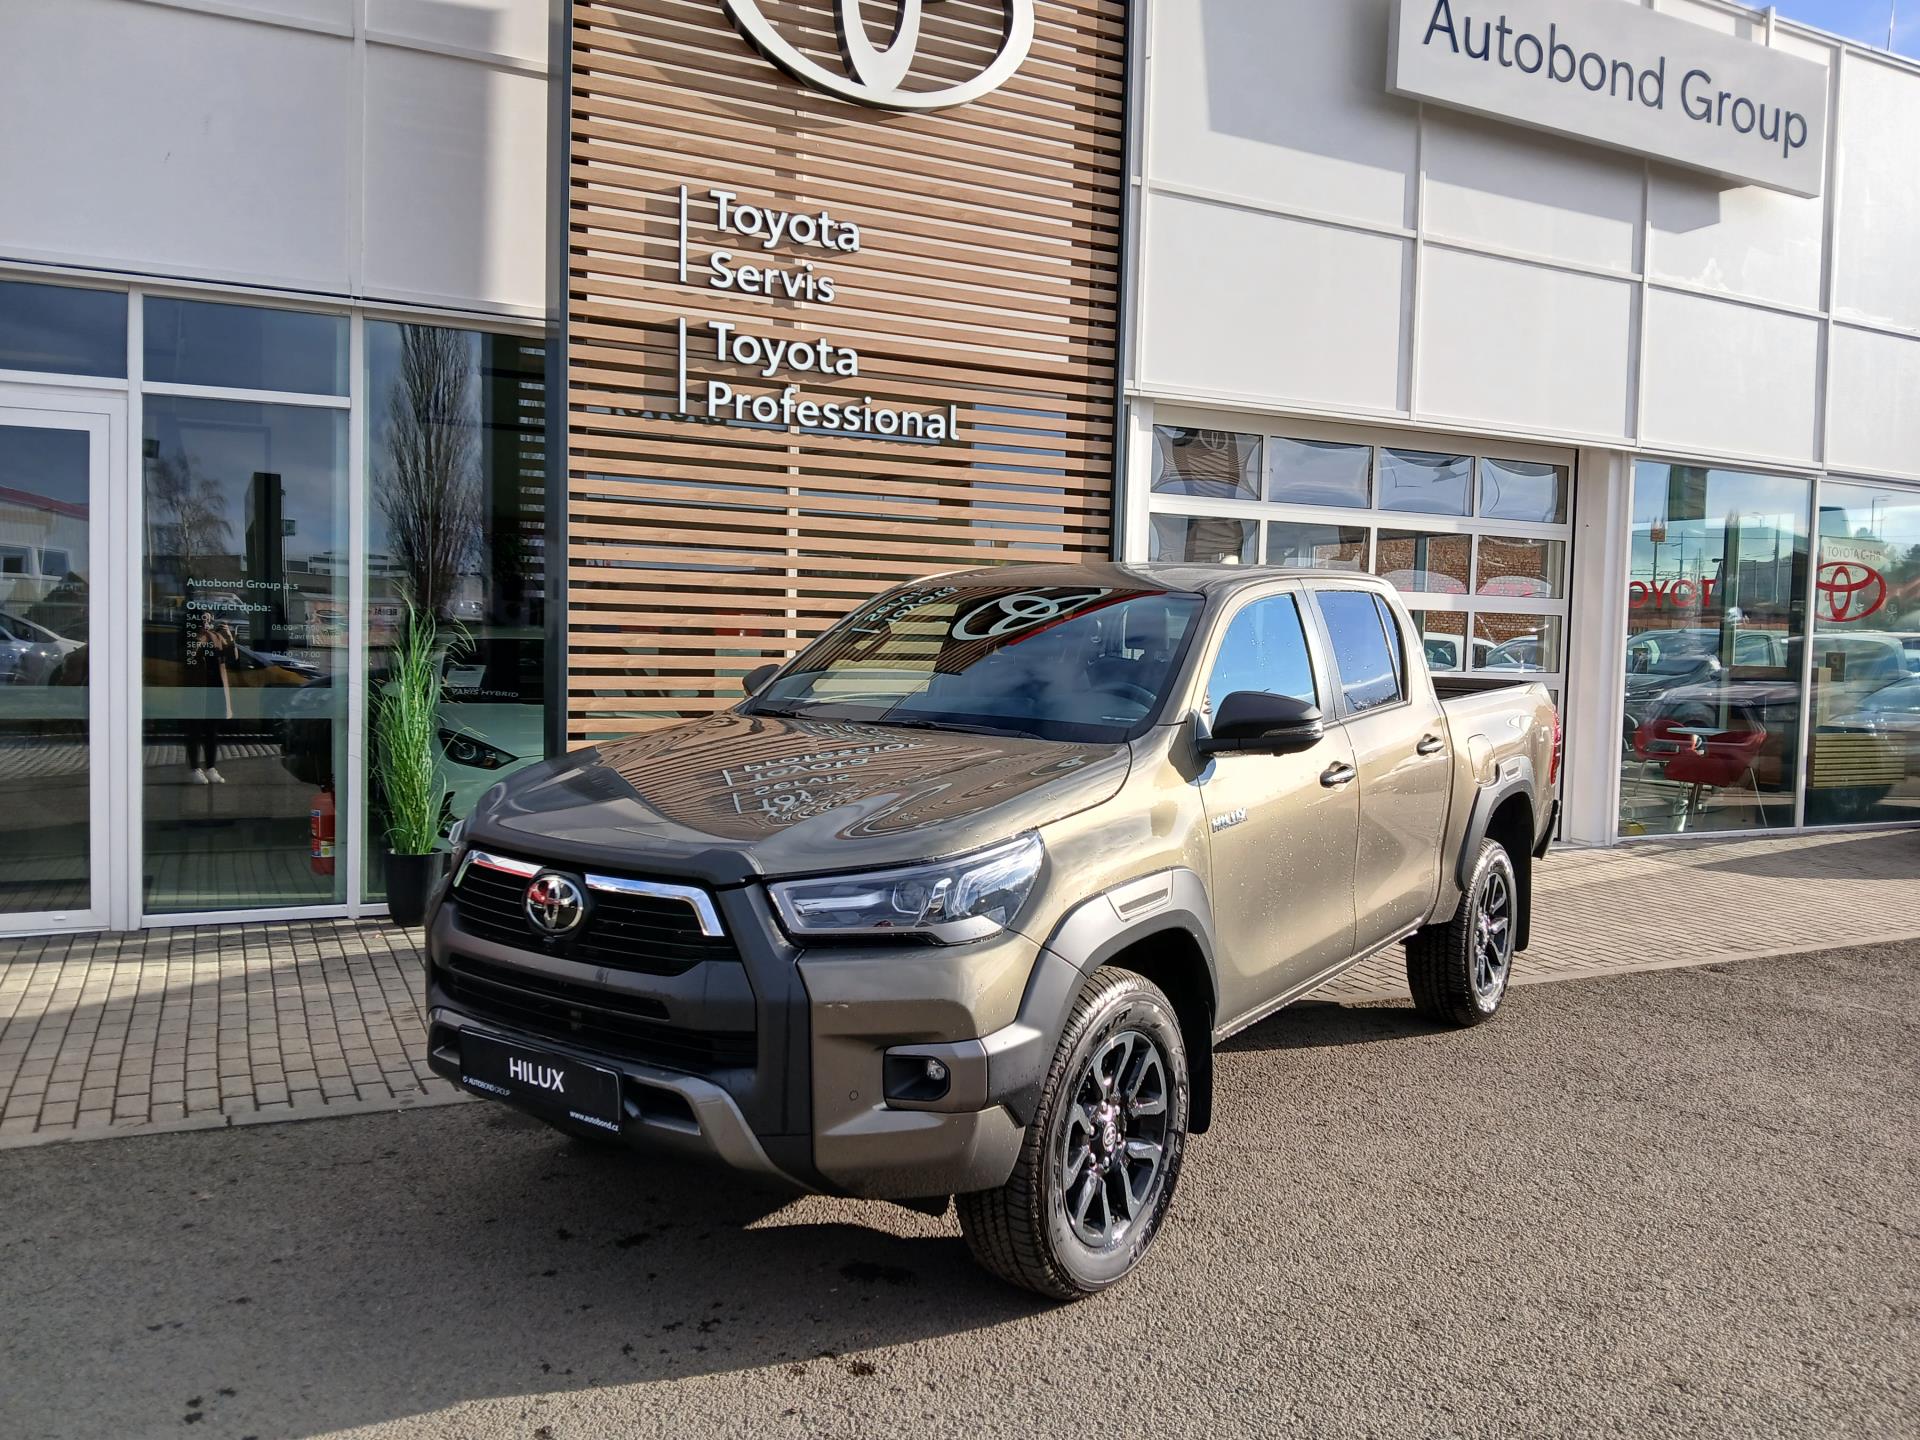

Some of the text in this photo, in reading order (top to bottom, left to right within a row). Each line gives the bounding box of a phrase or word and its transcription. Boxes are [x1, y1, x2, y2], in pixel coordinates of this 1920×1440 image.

[1423, 0, 1808, 158] Autobond Group
[709, 190, 862, 252] Toyota
[709, 251, 836, 302] Servis
[708, 320, 860, 378] Toyota
[707, 380, 960, 441] Professional
[186, 577, 244, 588] Autobond
[246, 579, 281, 591] Group
[239, 602, 272, 612] doba:
[481, 690, 519, 698] HYBRID
[509, 1057, 565, 1093] HILUX
